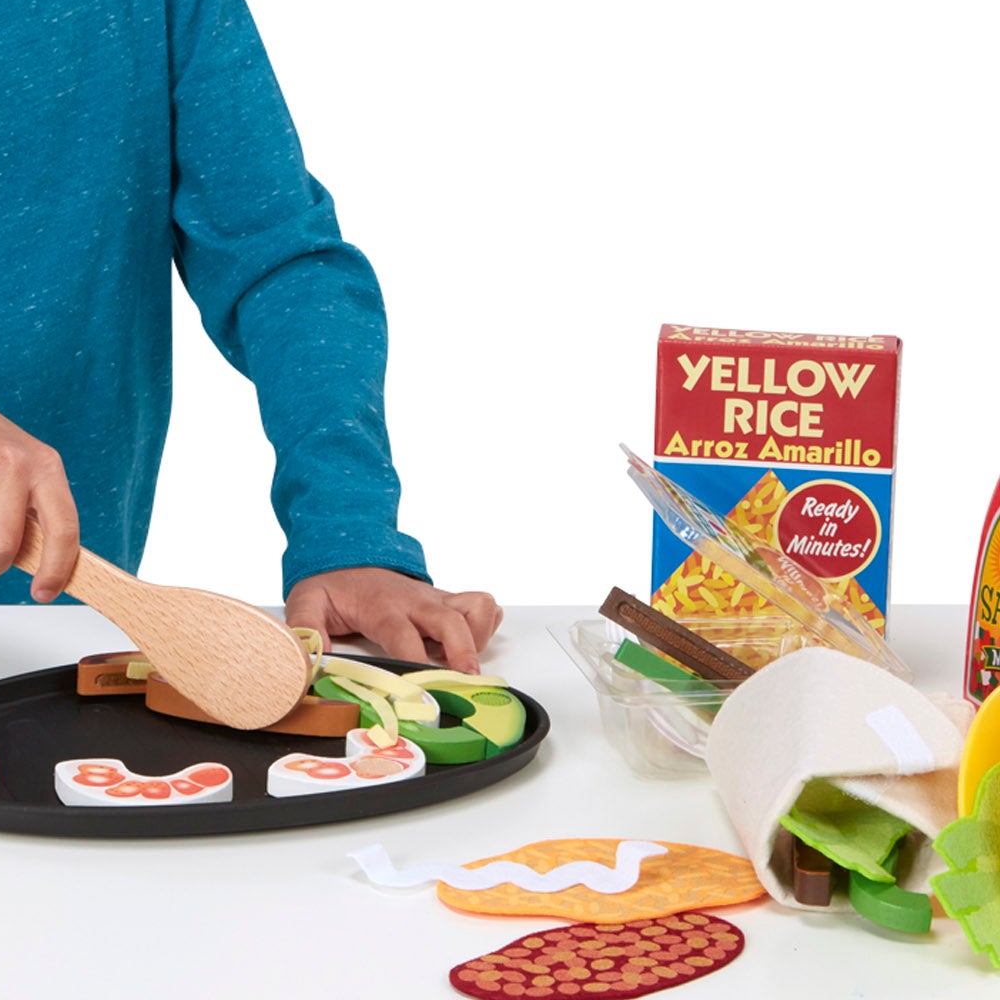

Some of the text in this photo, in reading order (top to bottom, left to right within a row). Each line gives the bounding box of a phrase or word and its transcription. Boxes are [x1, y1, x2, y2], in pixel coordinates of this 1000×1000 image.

[664, 332, 885, 350] Arroz Amarillo
[670, 325, 886, 344] YELLOW RICE
[676, 353, 876, 400] YELLOW
[723, 398, 824, 438] RICE
[664, 430, 882, 467] Arroz Amarillo
[801, 496, 860, 524] Ready
[819, 517, 838, 538] in
[786, 534, 872, 558] Minutes!
